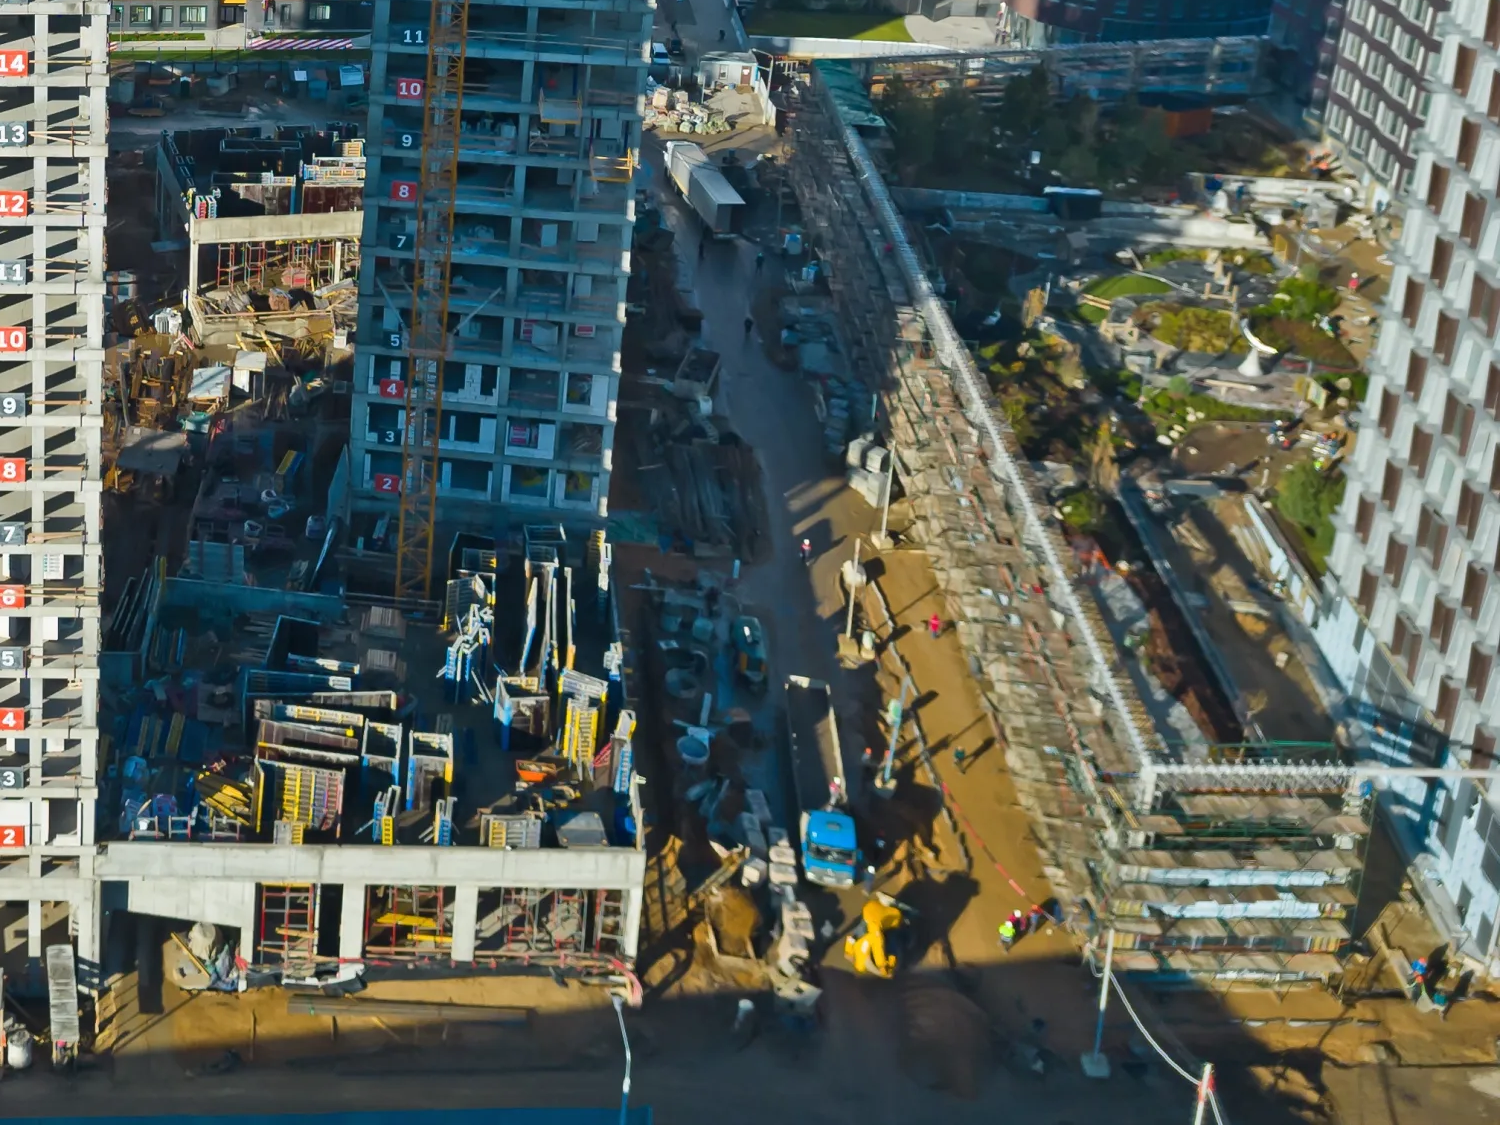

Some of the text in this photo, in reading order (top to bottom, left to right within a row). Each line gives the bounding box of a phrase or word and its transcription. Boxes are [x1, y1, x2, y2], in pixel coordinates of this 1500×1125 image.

[403, 29, 424, 44] 11
[399, 82, 421, 96] 10
[2, 396, 17, 415] 9
[2, 461, 17, 479] 8
[3, 525, 16, 543] 7
[1, 588, 16, 606] 6
[1, 650, 15, 667] 5
[1, 711, 17, 727] 4
[2, 770, 16, 787] 3
[2, 828, 16, 845] 2
